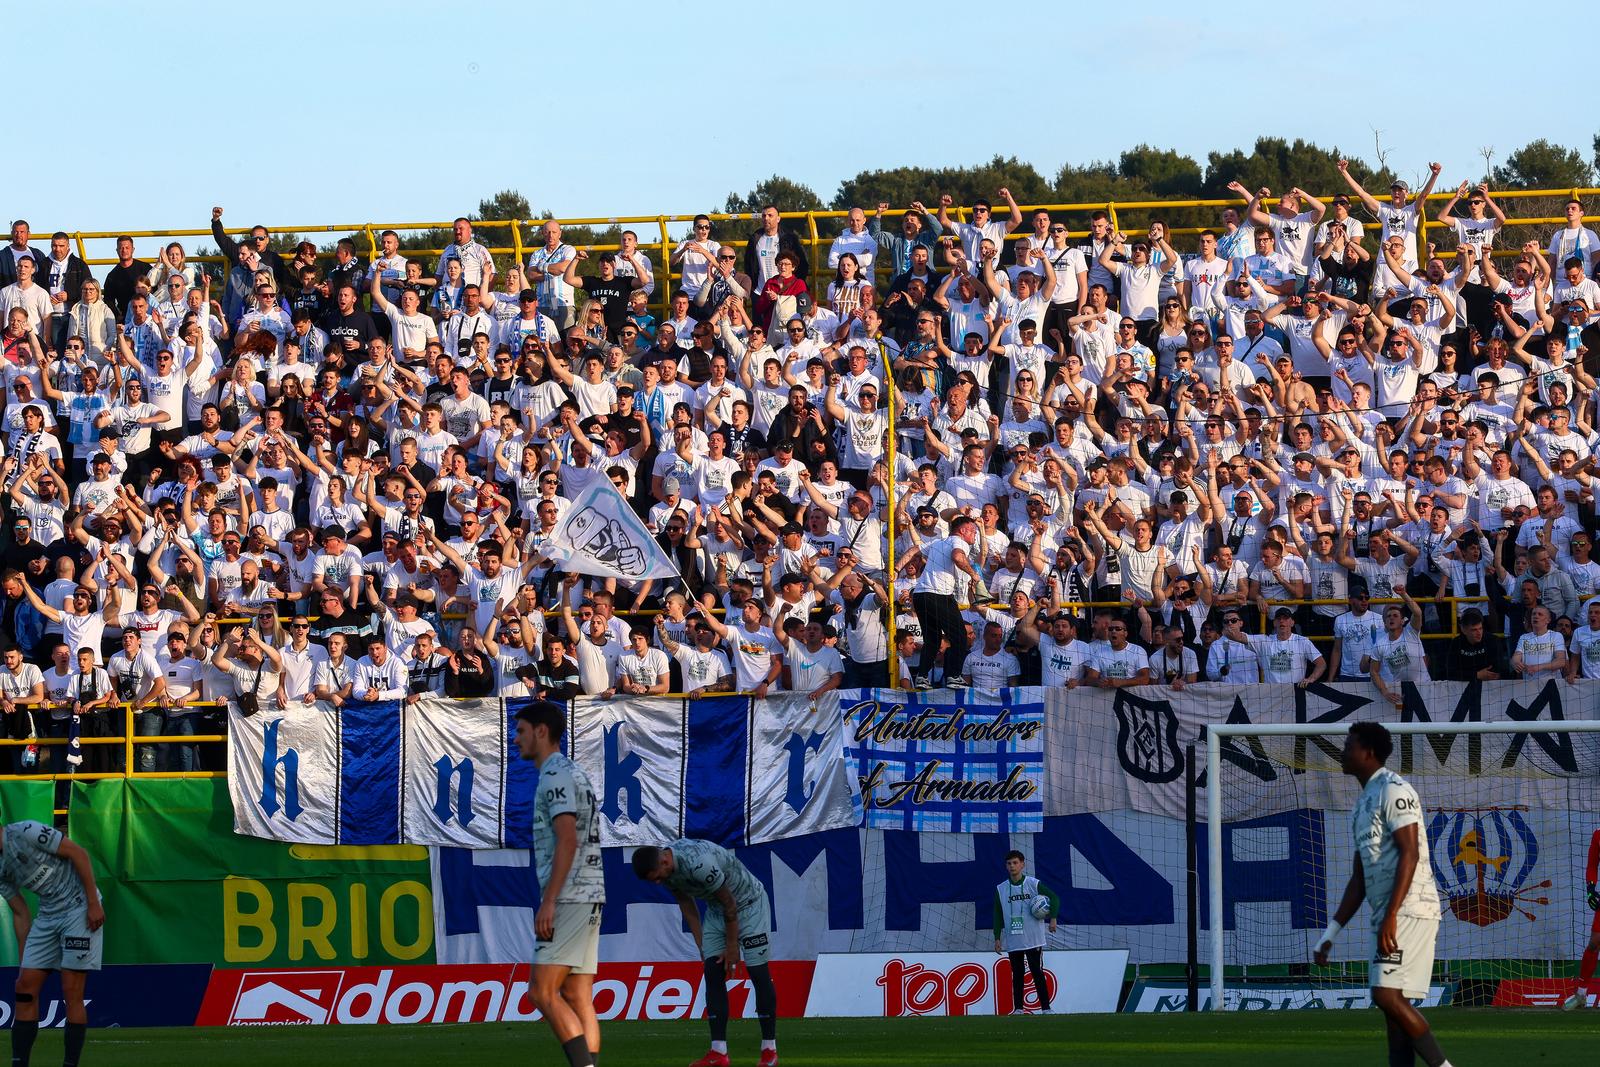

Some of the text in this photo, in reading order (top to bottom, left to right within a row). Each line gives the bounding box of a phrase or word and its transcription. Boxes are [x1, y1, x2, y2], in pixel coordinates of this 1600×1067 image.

[592, 289, 620, 298] RIJEKA
[331, 326, 359, 337] adidas
[843, 700, 1042, 744] United colors
[546, 787, 567, 802] OK
[874, 758, 1038, 809] Armada
[336, 965, 758, 1026] dompojekt
